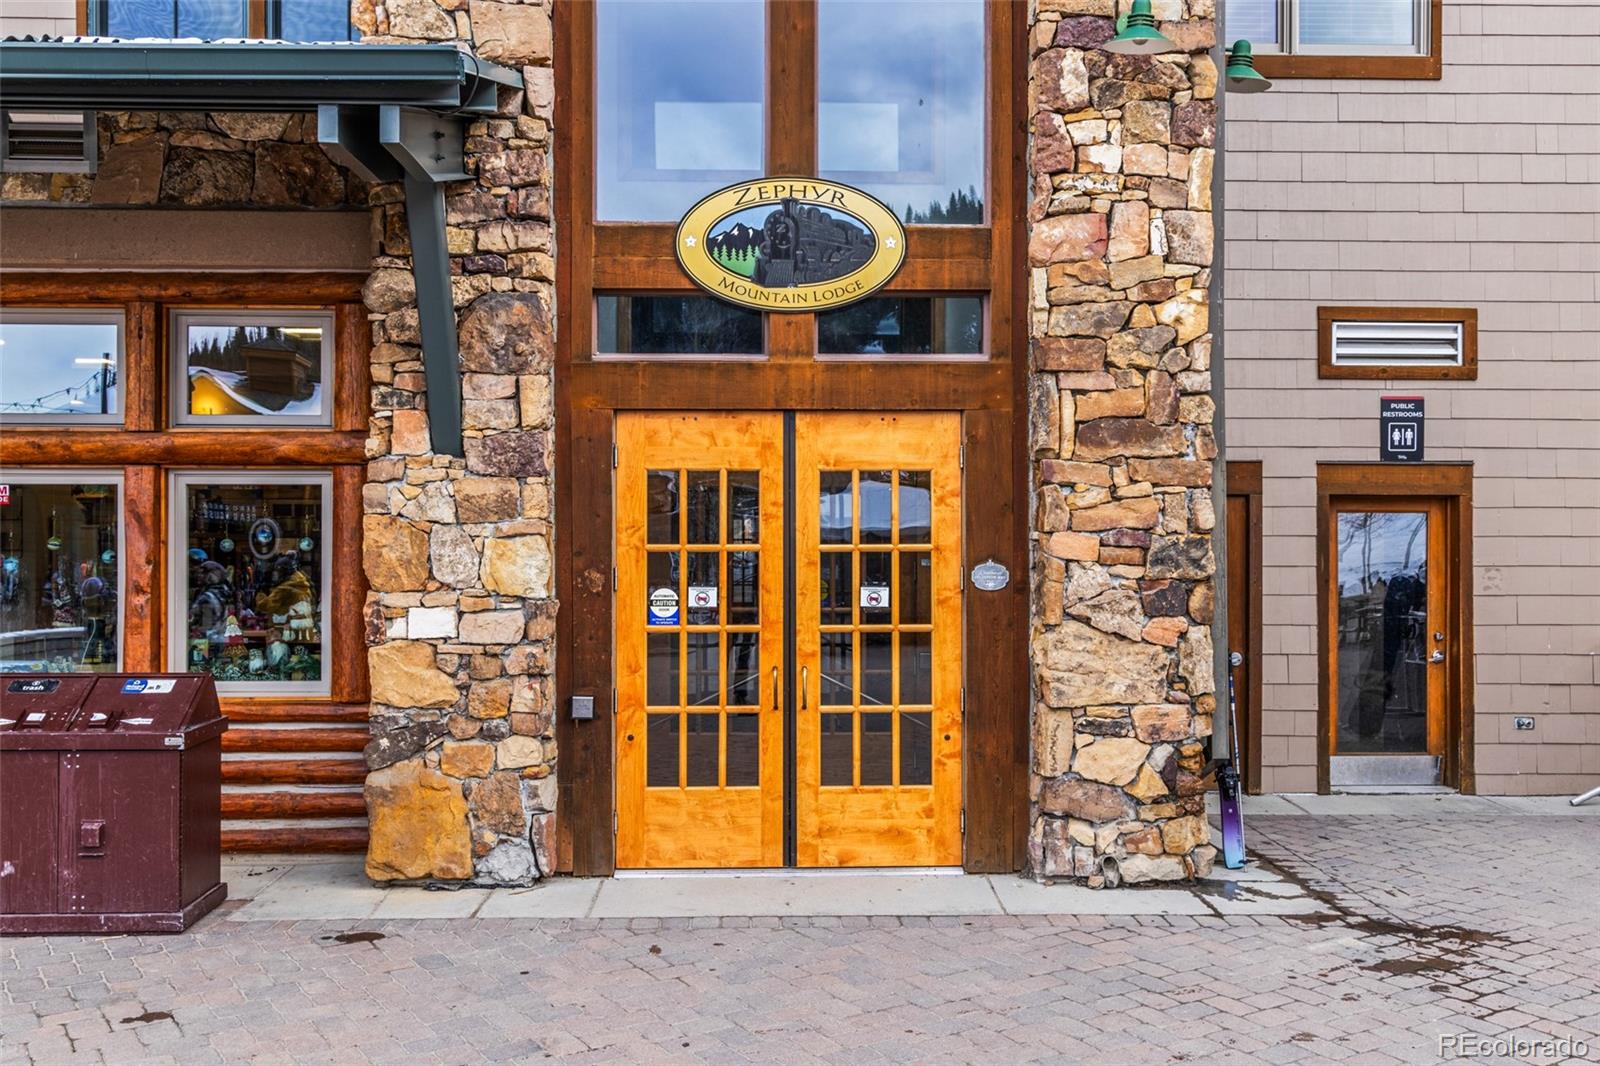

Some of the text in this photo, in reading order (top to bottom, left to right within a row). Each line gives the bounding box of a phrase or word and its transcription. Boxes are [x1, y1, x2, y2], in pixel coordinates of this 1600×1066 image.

[733, 184, 848, 208] ZEPHYR
[718, 277, 864, 304] MOUNTAIN LODGE
